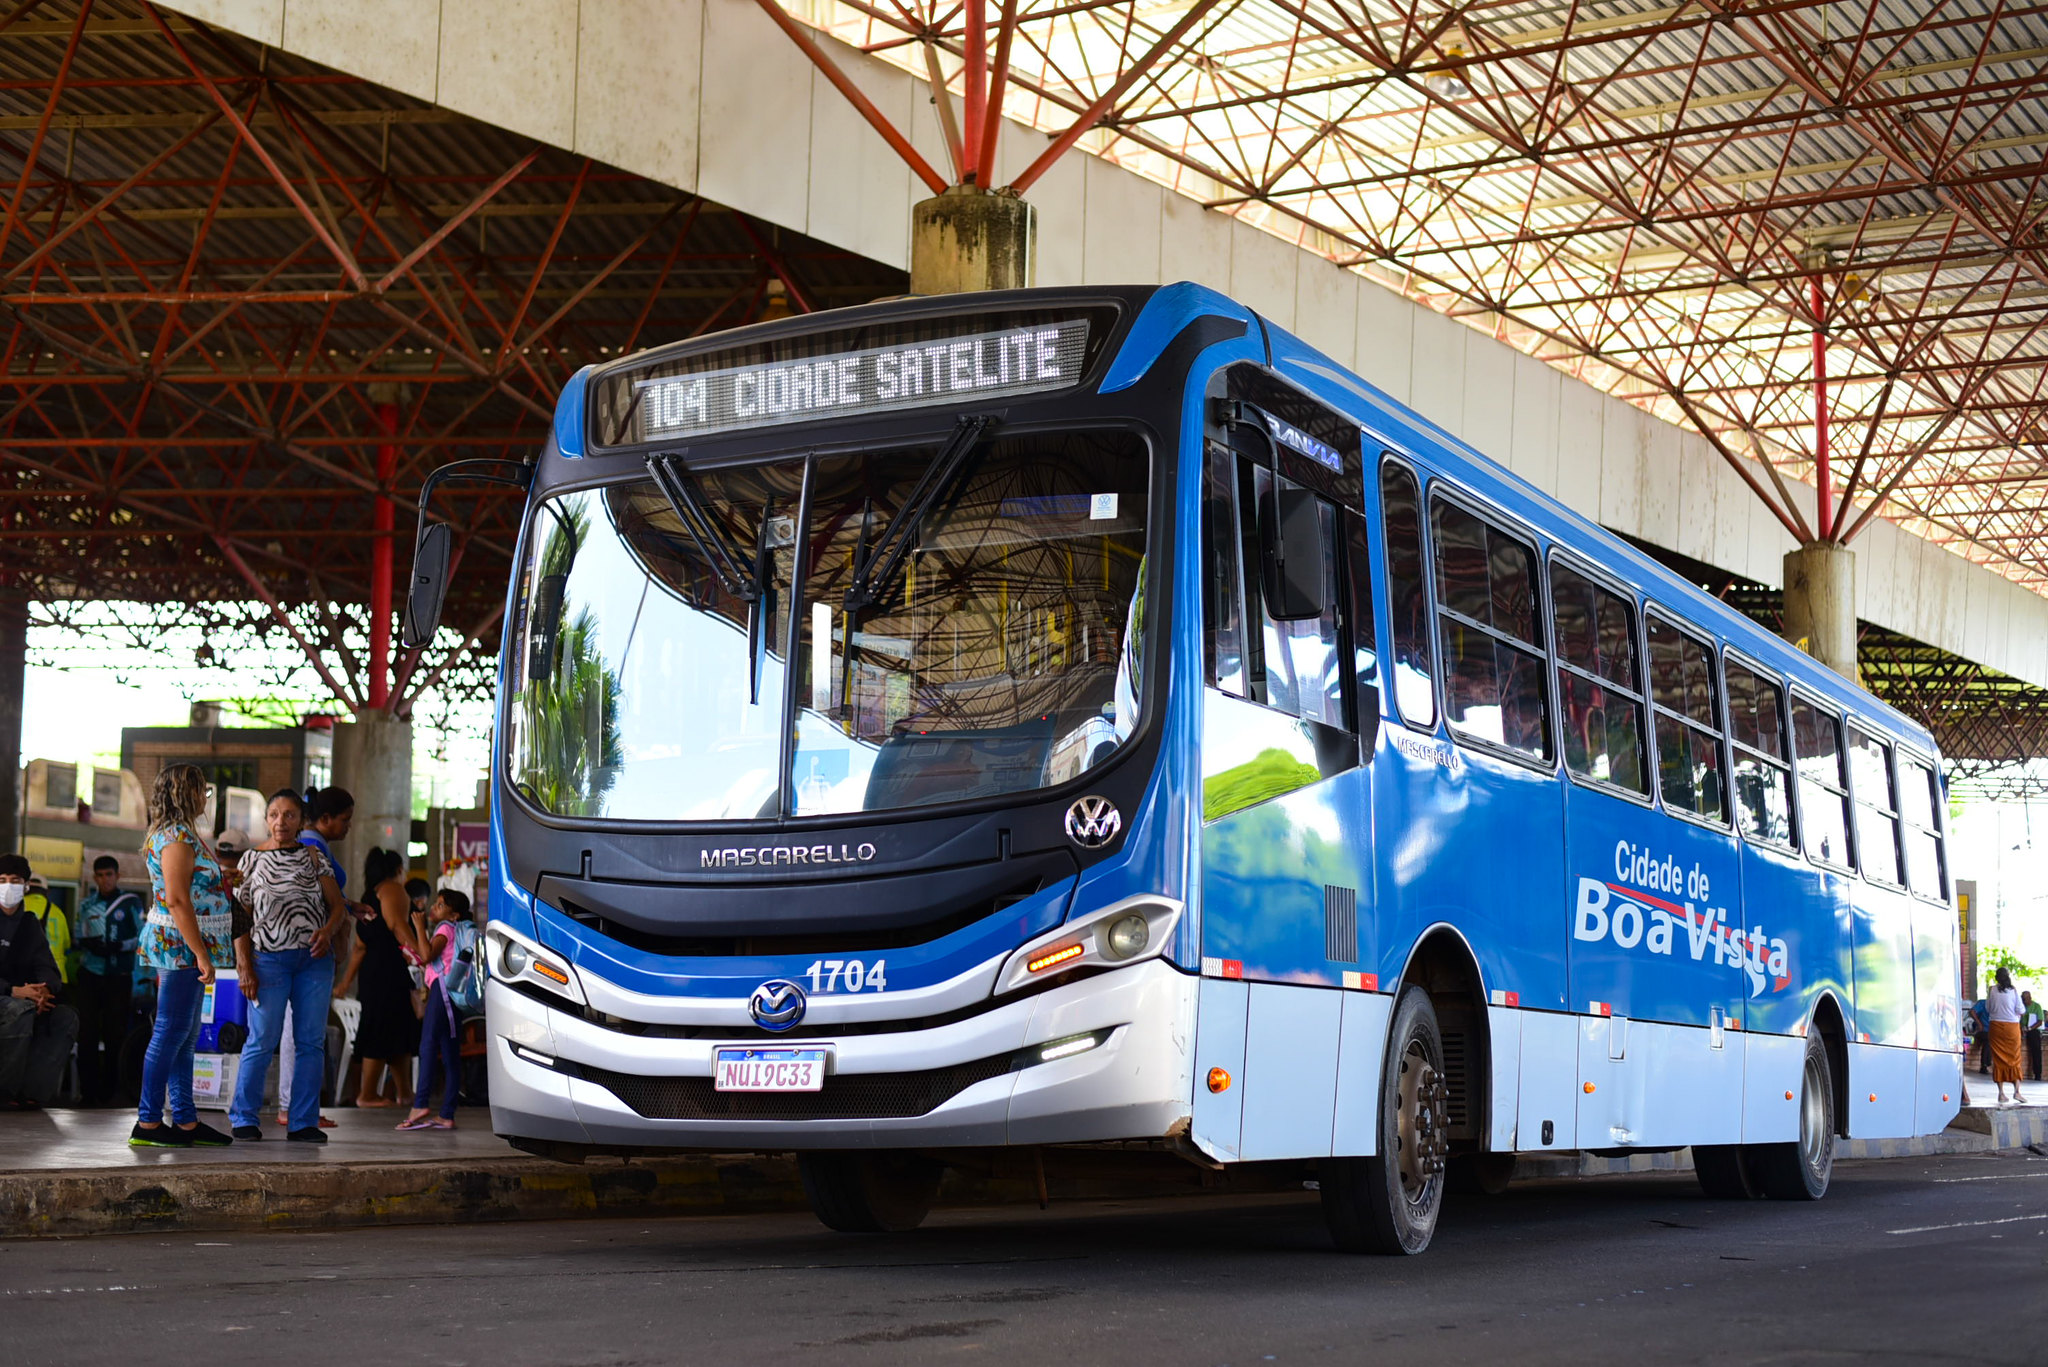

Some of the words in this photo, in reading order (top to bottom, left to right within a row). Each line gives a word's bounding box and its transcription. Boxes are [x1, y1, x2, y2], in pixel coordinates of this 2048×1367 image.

[647, 378, 707, 429] 104
[735, 357, 861, 418] CIDADE
[876, 328, 1060, 399] SATELITE
[1397, 736, 1459, 770] MASCARELLO
[700, 842, 877, 868] MASCARELLO
[1614, 839, 1684, 896] Cidade
[1687, 863, 1710, 902] de
[1573, 877, 1673, 955] Boa
[1683, 902, 1789, 979] Vista
[805, 959, 887, 993] 1704
[725, 1063, 812, 1086] NUI9C33
